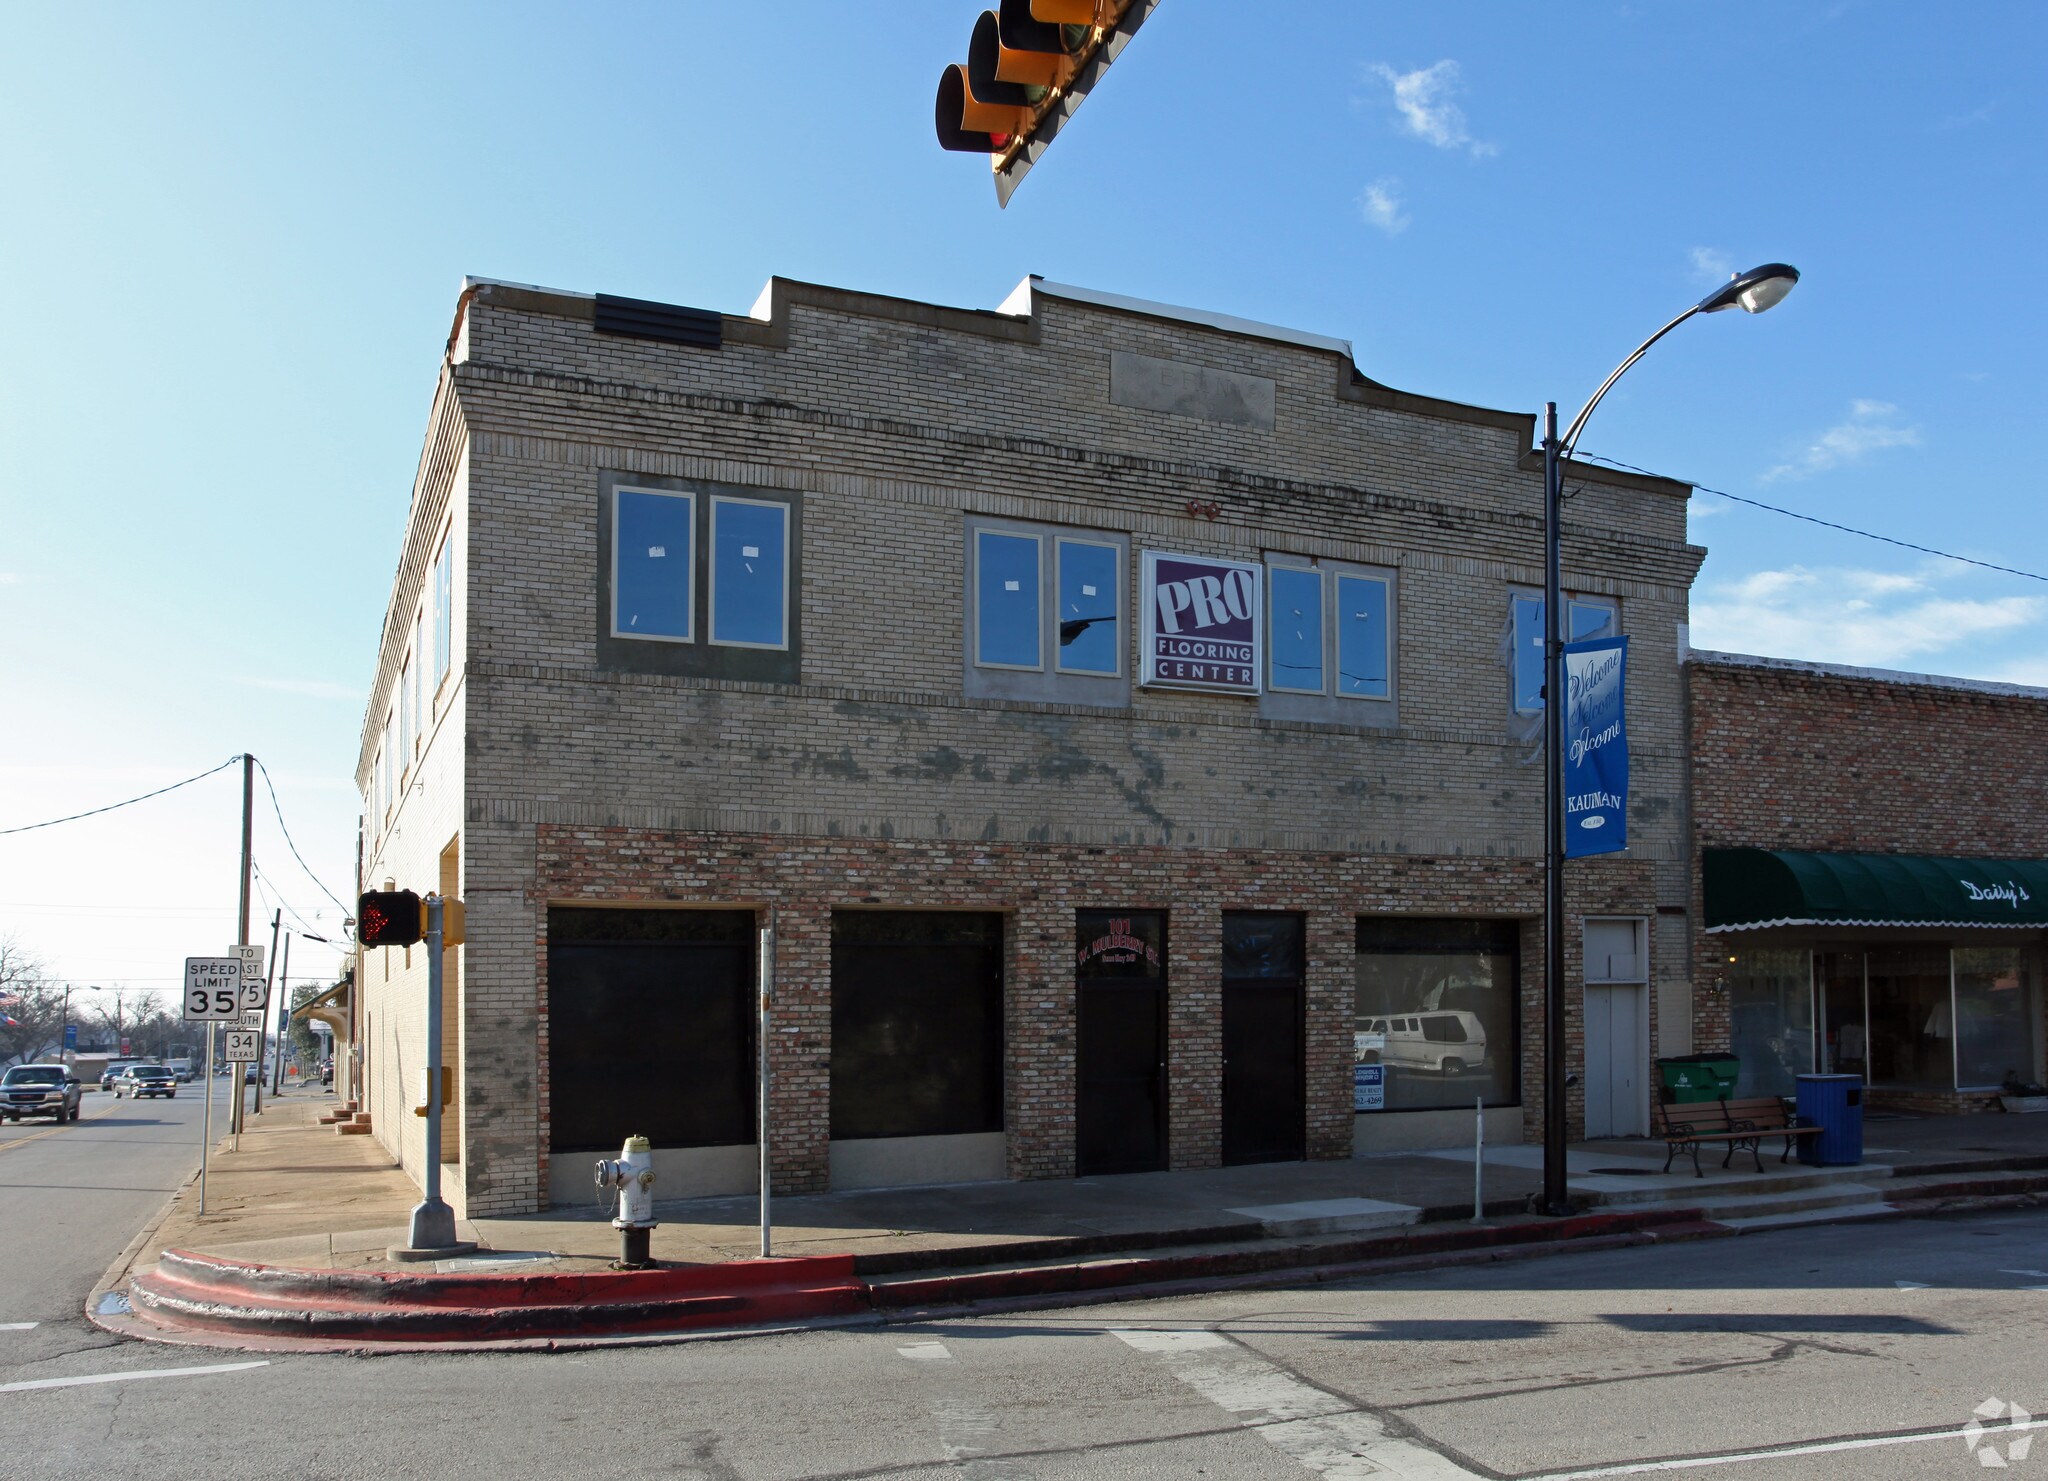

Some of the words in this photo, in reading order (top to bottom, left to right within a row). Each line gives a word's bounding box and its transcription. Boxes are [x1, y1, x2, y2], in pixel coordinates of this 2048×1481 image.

[1157, 570, 1253, 634] PRO
[1159, 640, 1251, 660] FLOORING
[1159, 662, 1251, 682] CENTER
[1569, 650, 1620, 701] Welcome
[1569, 719, 1621, 769] Wlcome
[1960, 880, 2030, 909] Daisy's
[1108, 918, 1130, 935] 101
[240, 949, 254, 958] TO
[1092, 935, 1145, 956] MULBERRY
[190, 965, 237, 975] SPEED
[242, 965, 258, 974] AST
[195, 978, 231, 987] LIMIT
[190, 991, 234, 1014] 35
[241, 986, 259, 1002] 75
[231, 1035, 253, 1048] 34
